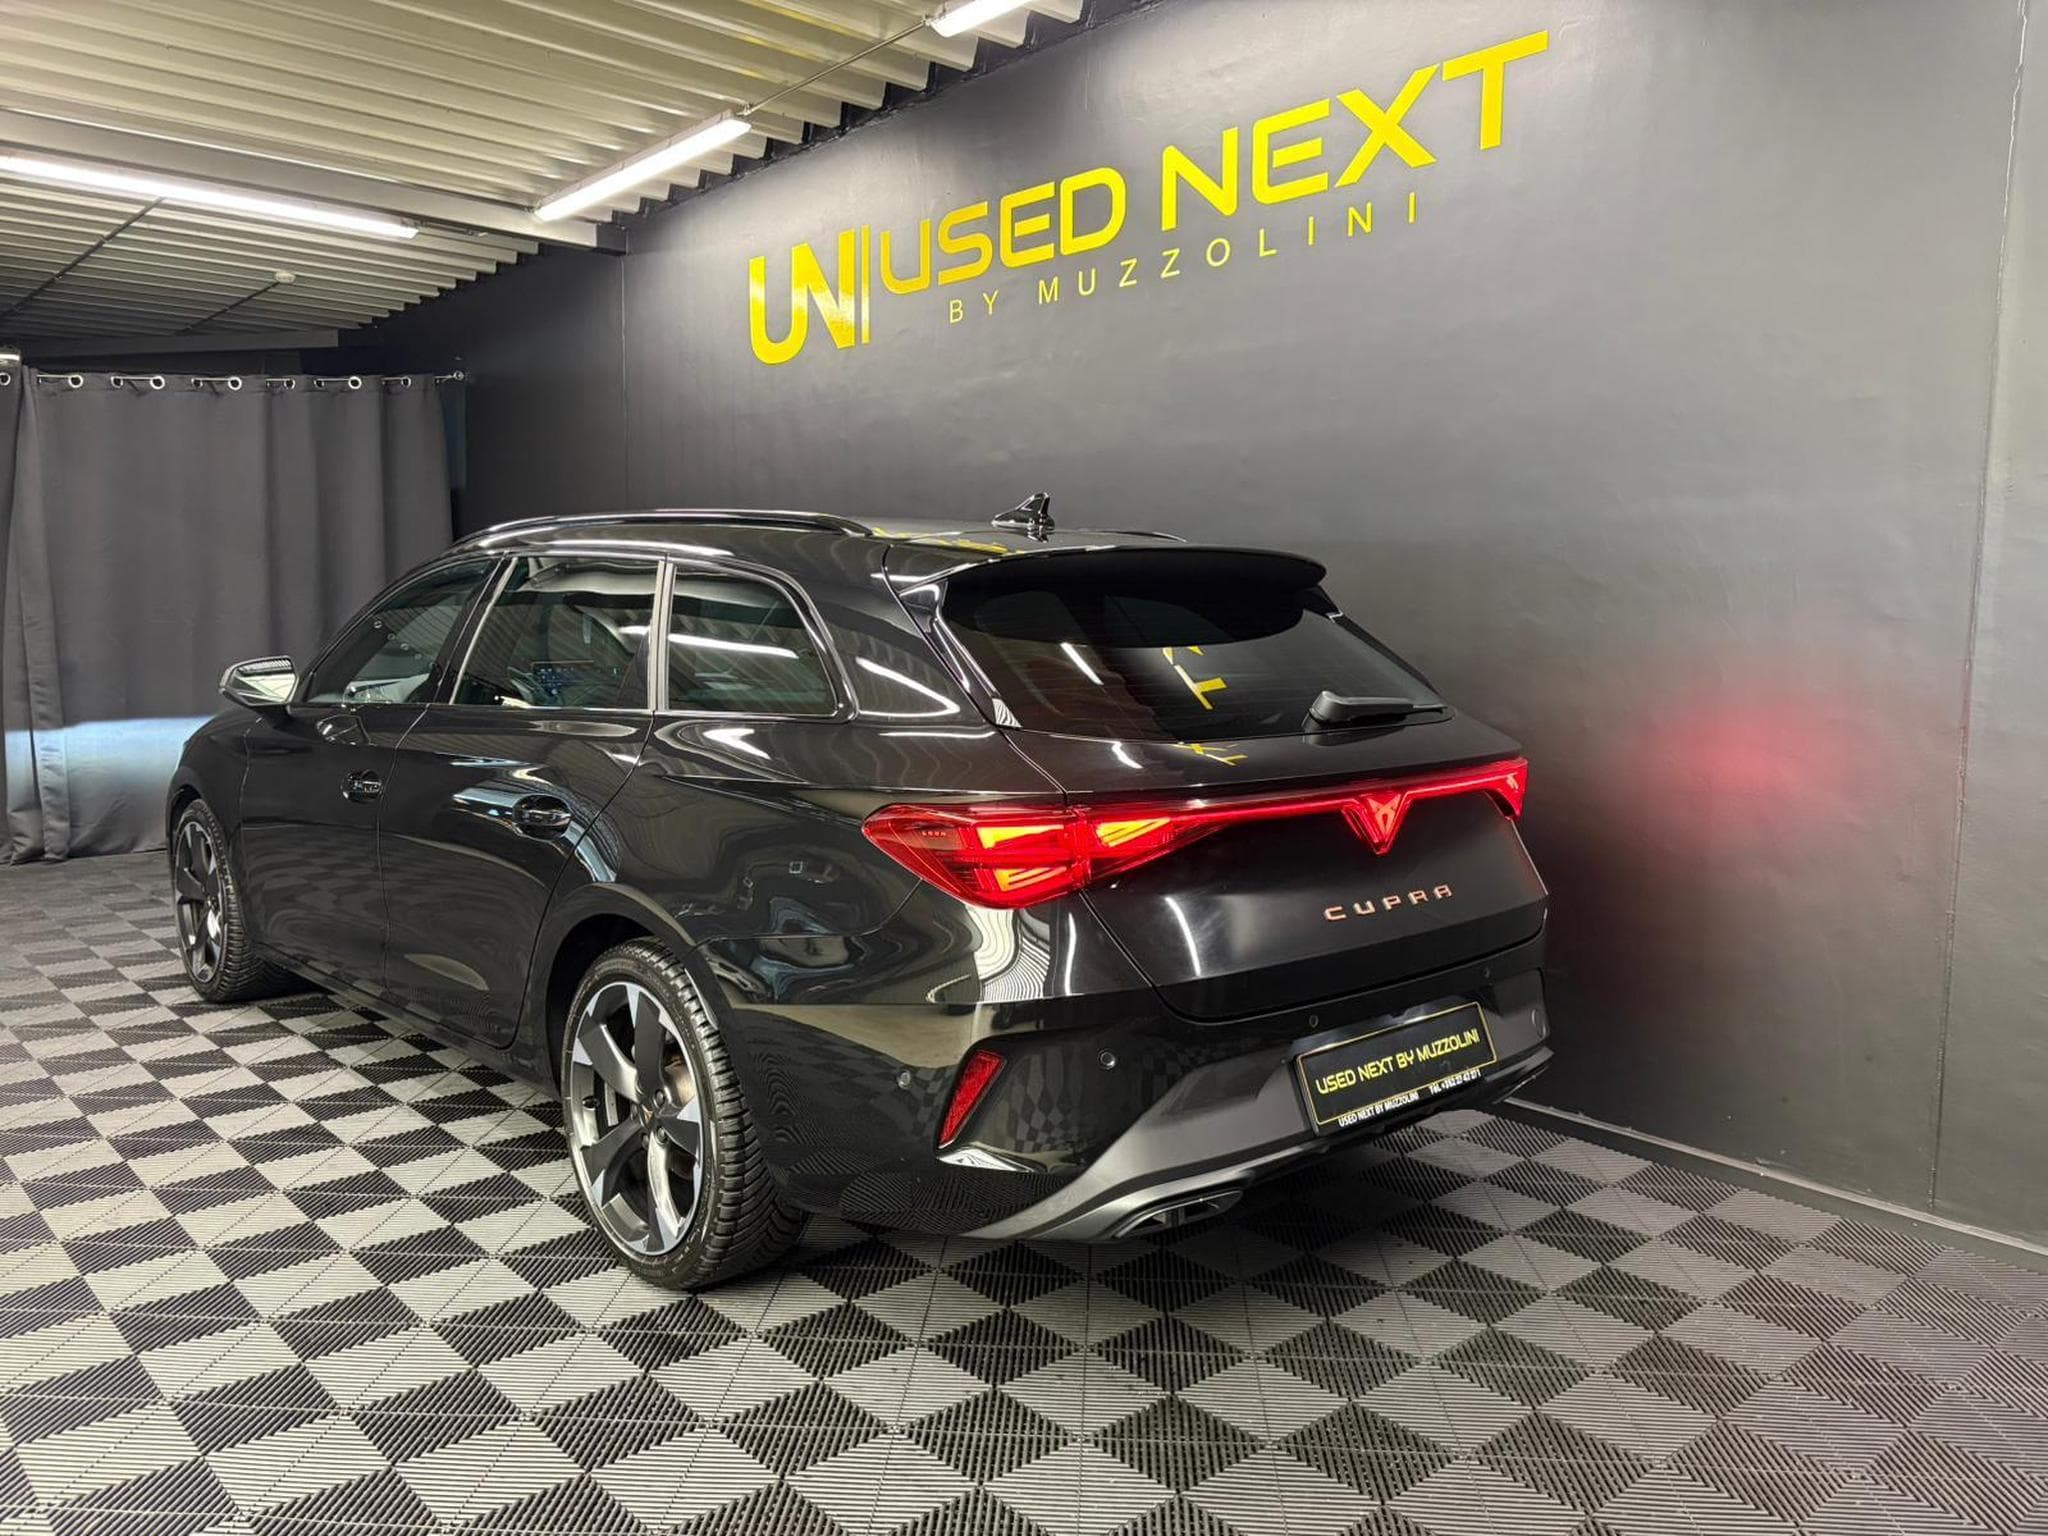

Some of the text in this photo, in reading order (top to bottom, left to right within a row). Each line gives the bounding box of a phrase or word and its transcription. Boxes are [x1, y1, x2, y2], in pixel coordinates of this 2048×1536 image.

[878, 166, 1130, 297] USED
[1159, 31, 1551, 233] NEXT
[949, 191, 1417, 324] BY MUZZOLINI
[1323, 883, 1453, 922] CUPRA
[1315, 1028, 1480, 1095] USED NEXT BY MUZZOLINI
[1338, 1114, 1357, 1128] USED
[1357, 1106, 1375, 1120] NEXT
[1375, 1103, 1384, 1115] BY
